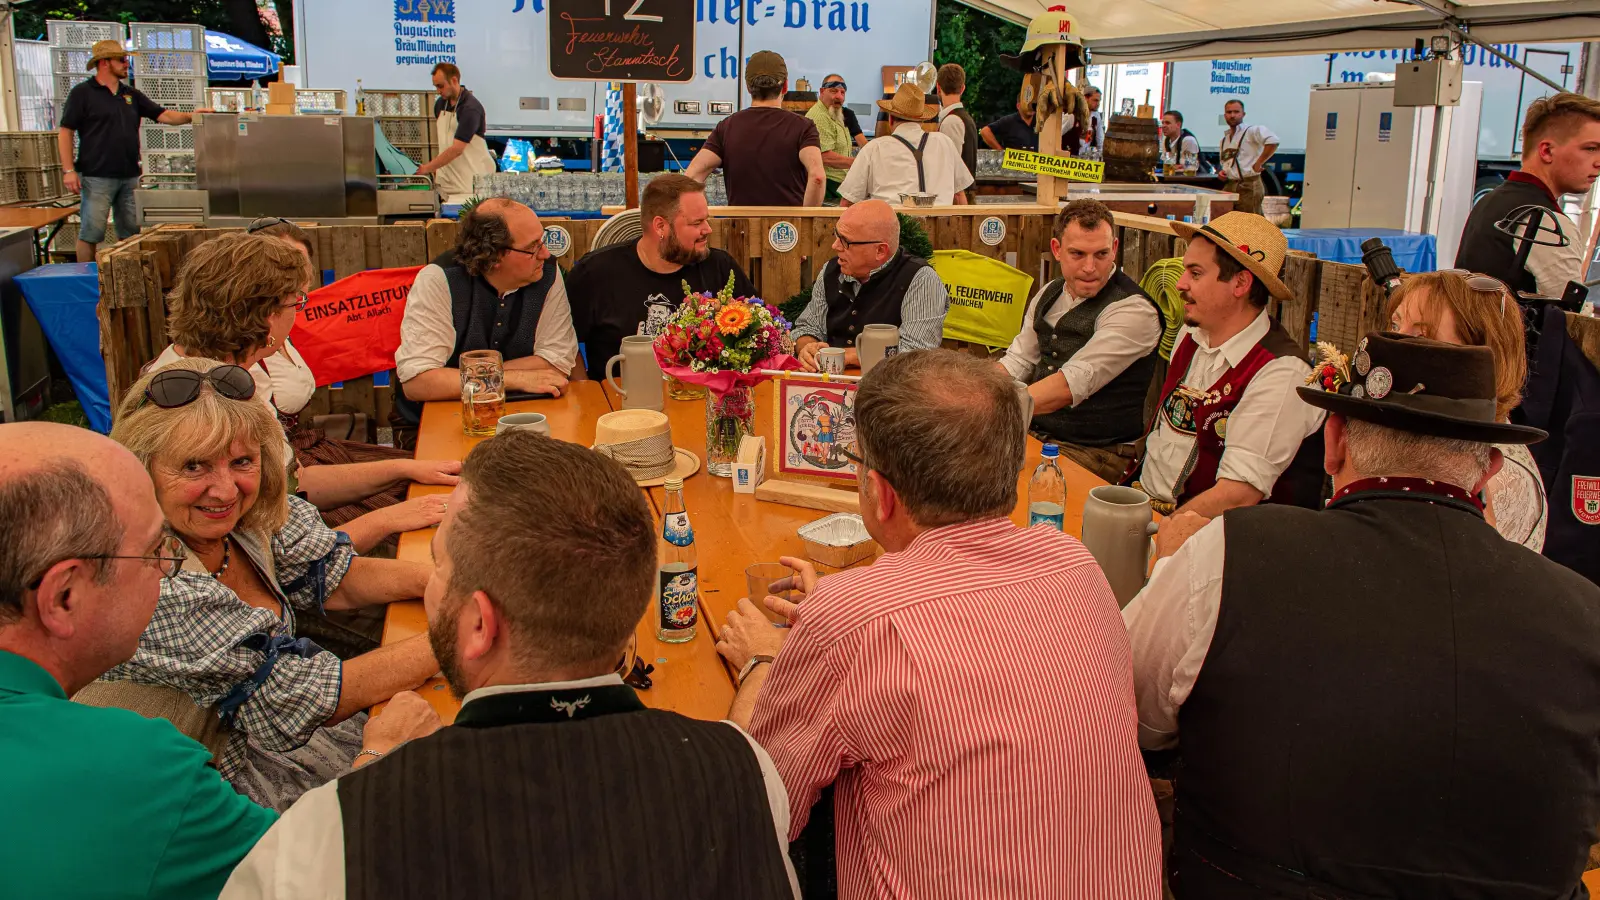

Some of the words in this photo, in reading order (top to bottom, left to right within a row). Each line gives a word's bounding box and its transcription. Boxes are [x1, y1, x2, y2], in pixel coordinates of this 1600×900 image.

[560, 12, 653, 55] Feuerwehr
[395, 38, 417, 51] Bräu
[417, 40, 456, 53] München
[586, 44, 685, 77] Stammtisch
[1008, 151, 1101, 172] WELTBRANDRAT
[1039, 165, 1071, 176] FEUERWEHR
[1073, 171, 1100, 180] MÜNCHEN
[304, 284, 413, 322] EINSATZLEITUN
[949, 297, 984, 310] MÜNCHEN
[956, 285, 1014, 305] FEUERWEHR
[346, 313, 364, 323] Abt.
[366, 306, 392, 319] Allach
[1578, 481, 1600, 490] FREIWILL
[1577, 490, 1600, 499] FEUERWE
